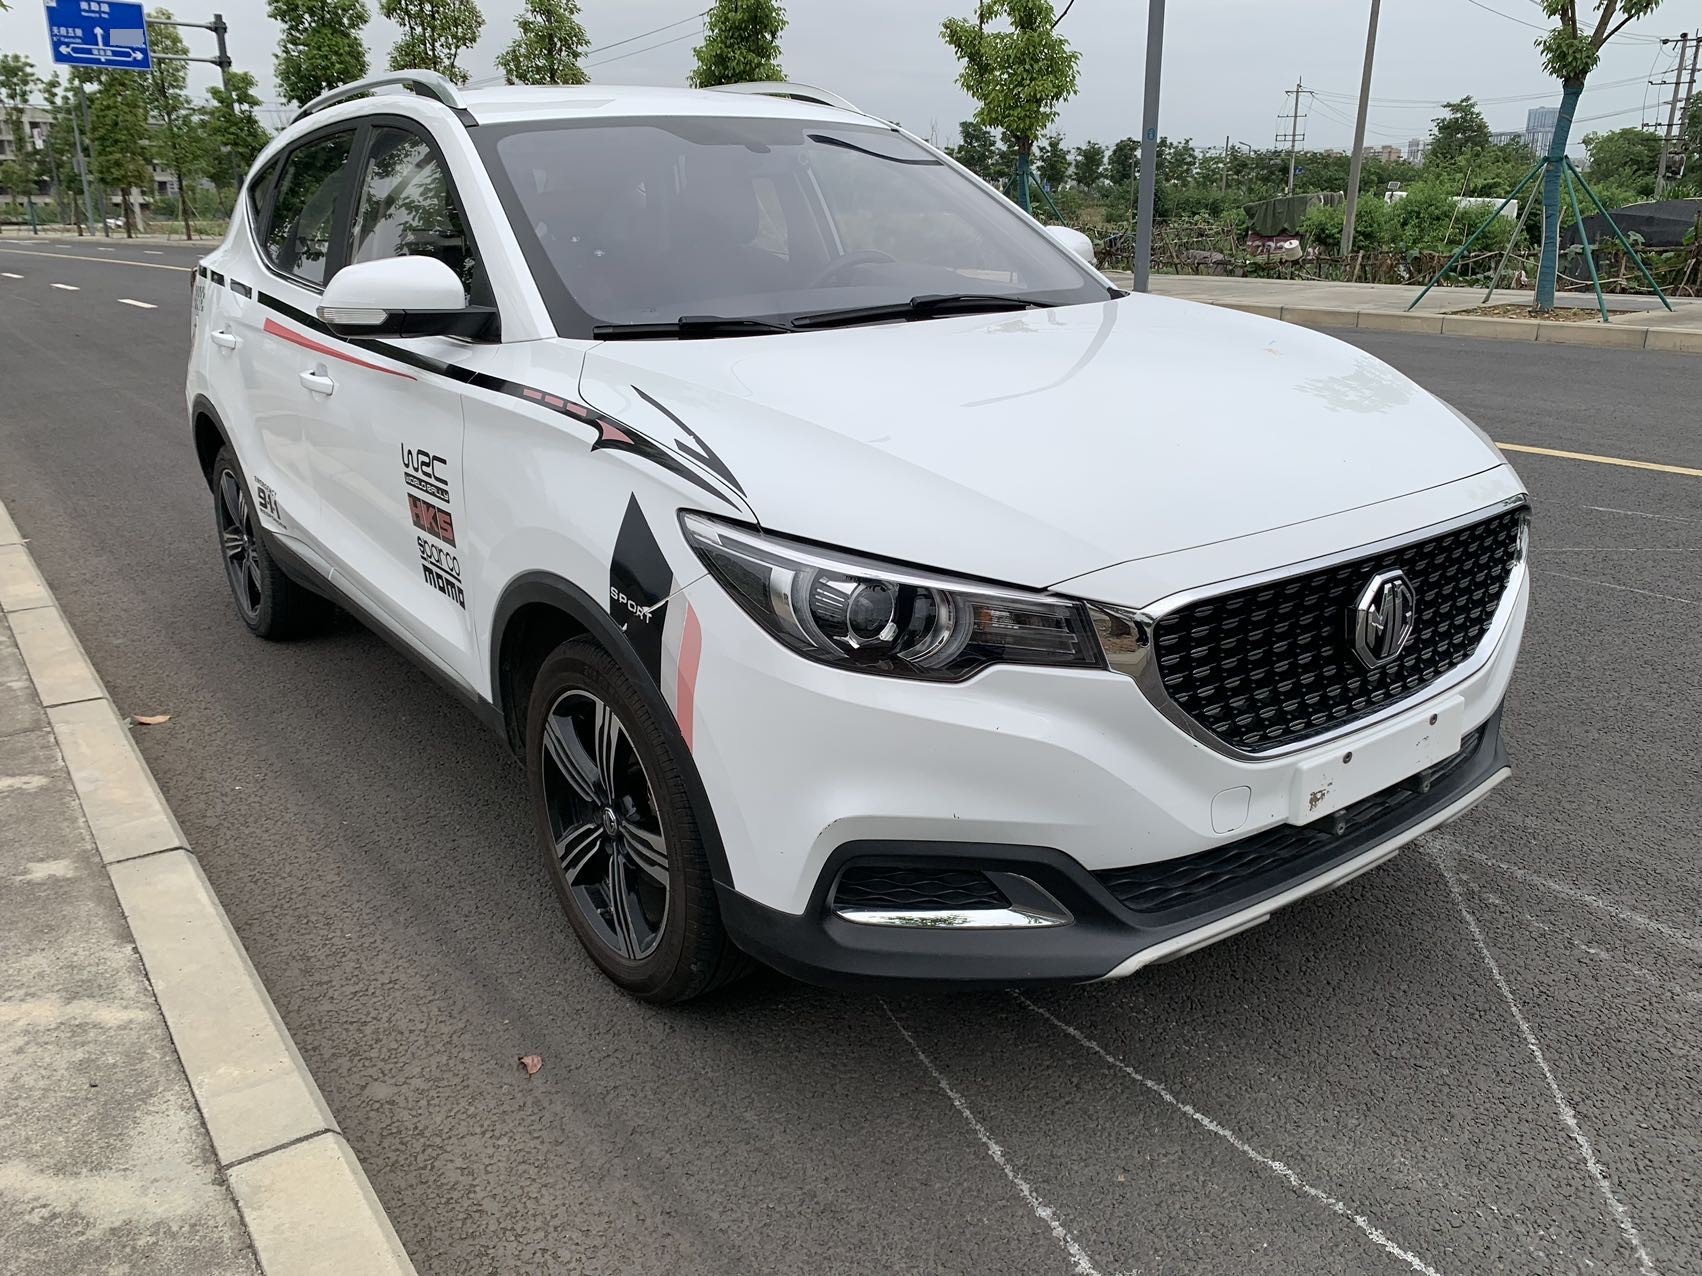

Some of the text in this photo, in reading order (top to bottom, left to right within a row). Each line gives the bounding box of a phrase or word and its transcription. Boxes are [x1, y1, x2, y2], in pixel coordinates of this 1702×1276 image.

[401, 443, 449, 486] WRC
[408, 496, 454, 541] HKS
[417, 535, 461, 577] sparco
[610, 586, 653, 624] SPORT
[1366, 580, 1413, 658] MG
